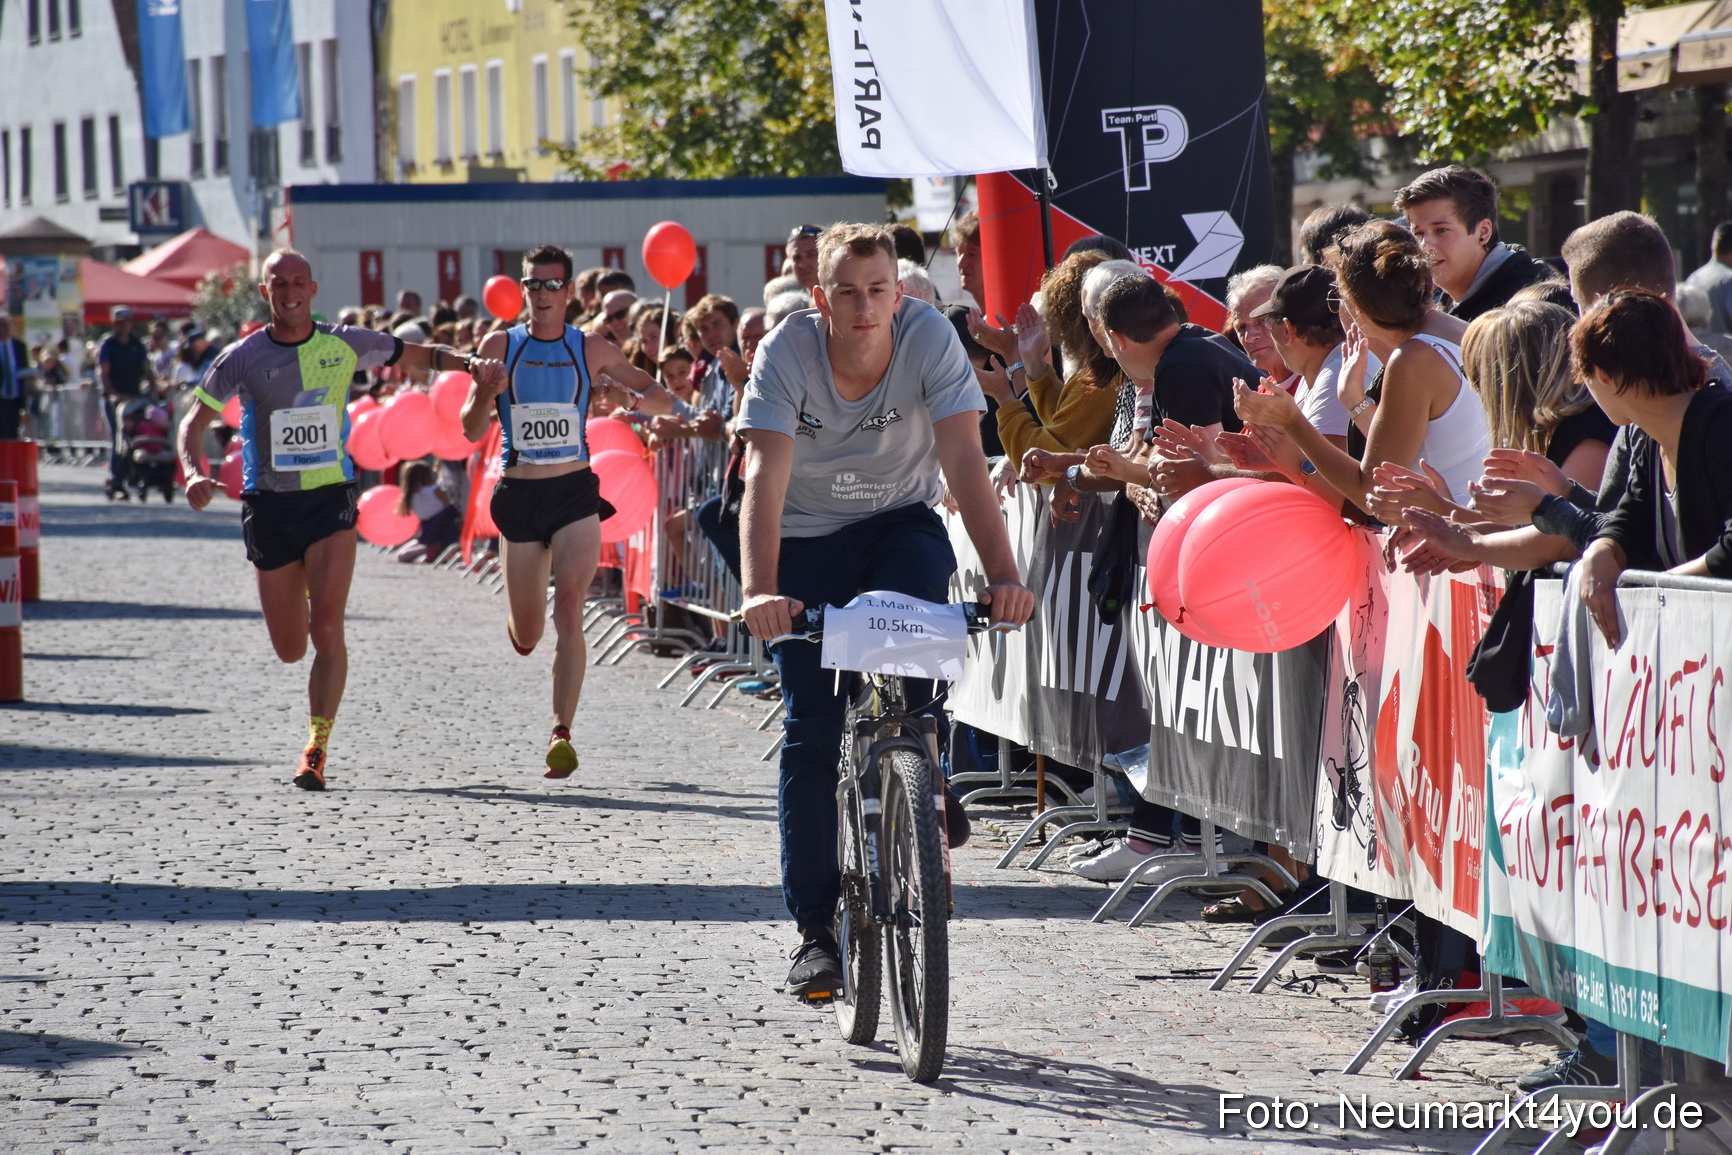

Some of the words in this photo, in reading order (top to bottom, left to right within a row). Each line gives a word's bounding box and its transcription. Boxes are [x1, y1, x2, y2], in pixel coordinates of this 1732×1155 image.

[1108, 115, 1133, 125] Team
[282, 424, 327, 445] 2001
[522, 419, 569, 440] 2000
[535, 449, 561, 459] Marco
[293, 455, 321, 465] Florian
[835, 473, 862, 484] 19.
[831, 482, 898, 492] Neumarkter
[866, 599, 925, 613] 1.Mann
[868, 617, 924, 634] 10.5km
